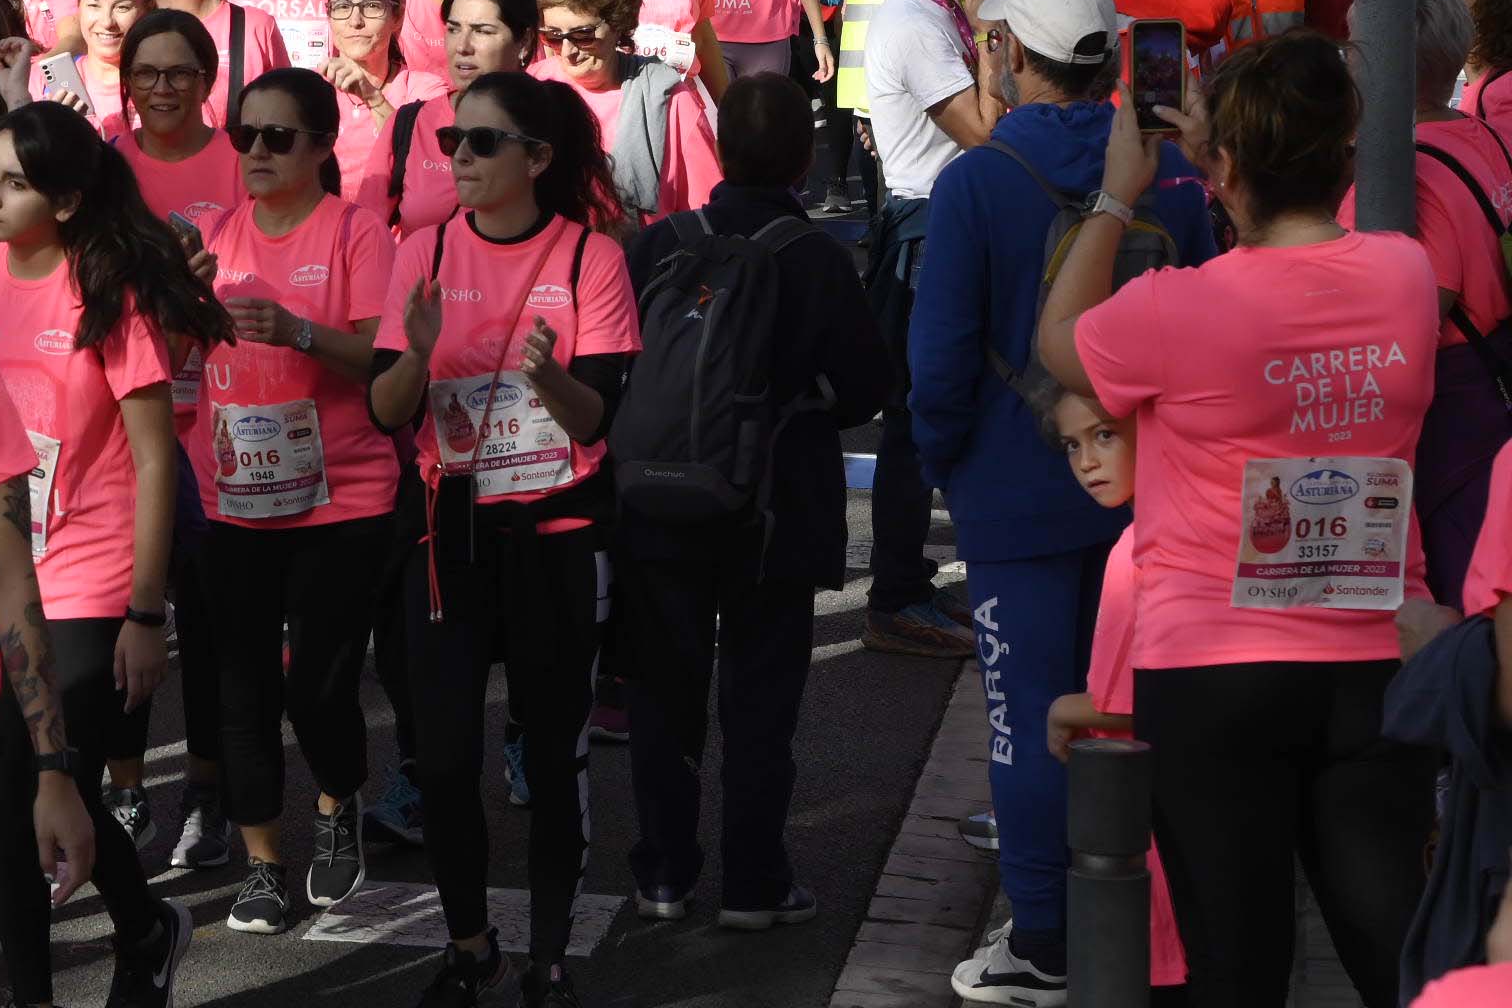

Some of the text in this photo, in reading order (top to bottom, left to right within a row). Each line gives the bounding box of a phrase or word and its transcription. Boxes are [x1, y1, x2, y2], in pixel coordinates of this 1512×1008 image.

[255, 0, 327, 18] ORSAL
[440, 287, 482, 303] YSHO
[1264, 340, 1407, 386] CARRERA
[1296, 370, 1382, 407] DE LA
[1290, 397, 1385, 434] MUJER
[479, 417, 521, 439] 016
[1327, 431, 1353, 442] 2023
[485, 441, 517, 455] 28224
[240, 449, 281, 468] 016
[491, 459, 501, 468] DE
[502, 458, 510, 467] LA
[511, 455, 537, 466] MUJER
[540, 452, 558, 461] 2023
[249, 470, 275, 481] 1948
[1366, 477, 1399, 487] SUMA
[1295, 484, 1354, 498] ASTURIANA
[1295, 516, 1348, 538] 016
[1298, 544, 1339, 558] 33157
[1256, 564, 1387, 576] CARRERA DE LA MUJER 2023
[1248, 584, 1390, 599] OYSHO Santander
[973, 596, 1013, 766] BARÇA
